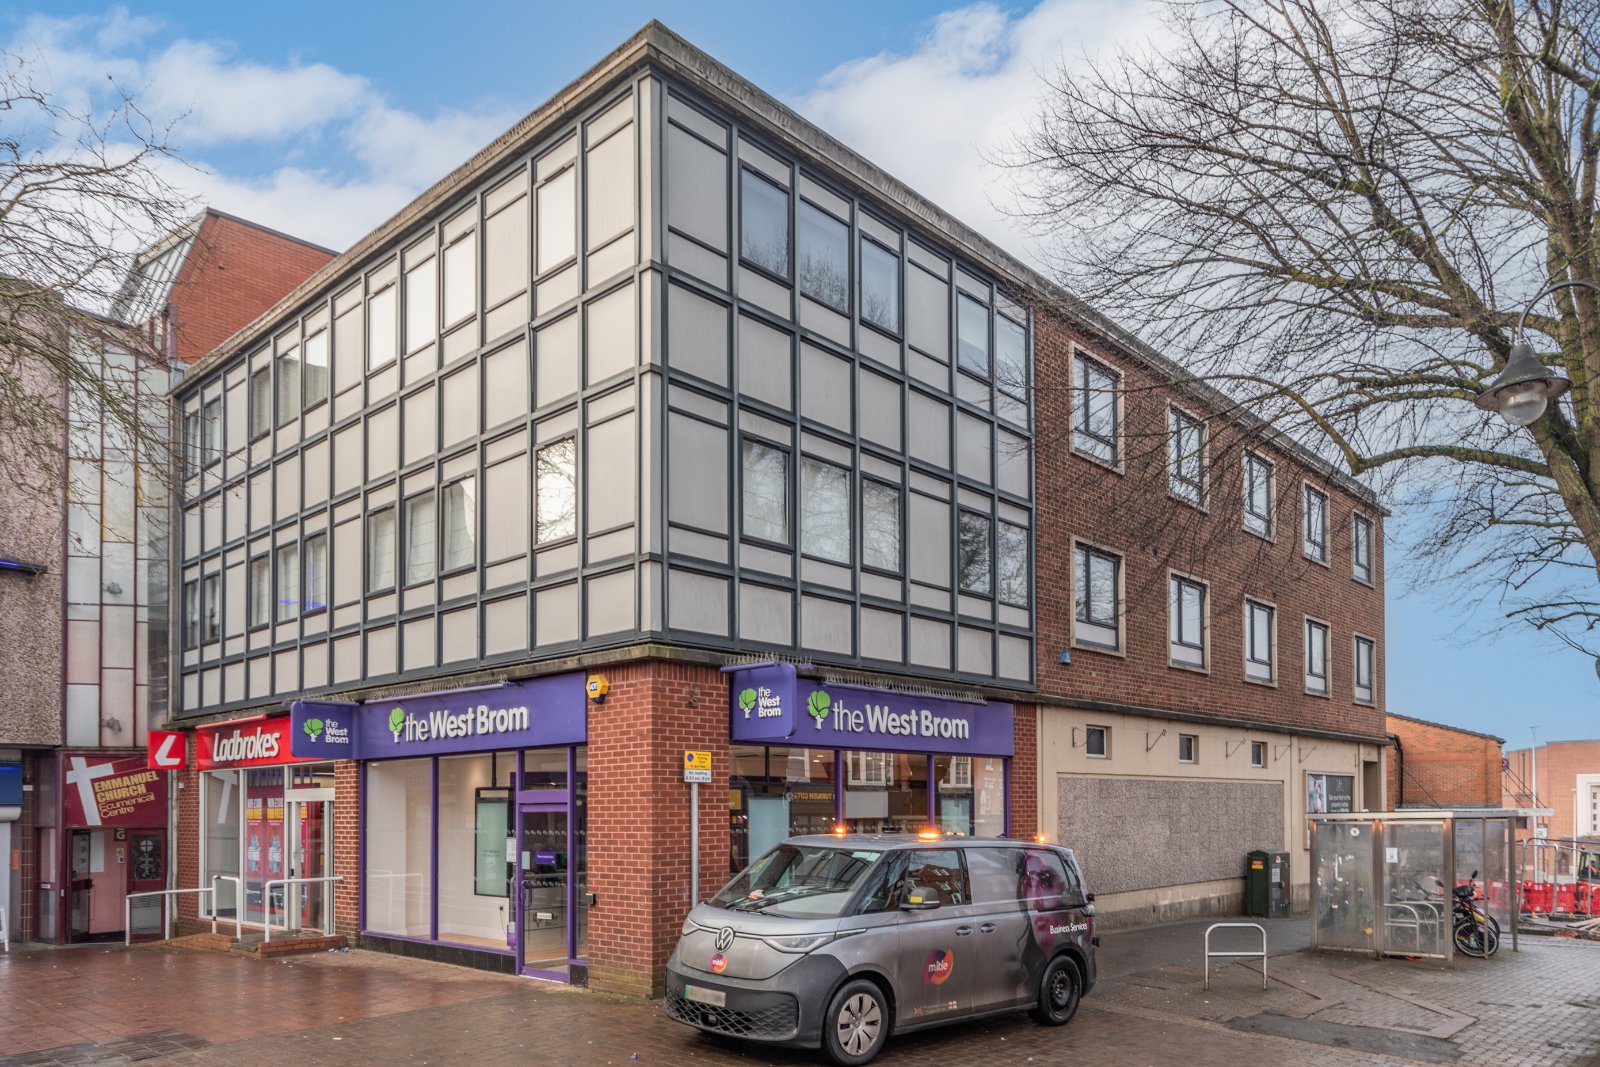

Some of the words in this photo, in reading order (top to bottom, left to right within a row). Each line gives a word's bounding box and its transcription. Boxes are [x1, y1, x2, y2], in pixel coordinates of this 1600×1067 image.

[758, 686, 771, 697] the
[758, 696, 780, 707] West
[758, 707, 781, 718] Brom
[325, 718, 338, 728] the
[404, 712, 428, 742] the
[430, 707, 474, 739] West
[476, 704, 528, 734] Brom
[832, 700, 864, 732] the
[866, 704, 918, 736] West
[920, 710, 969, 739] Brom
[325, 727, 348, 736] West
[212, 726, 280, 762] Ladbrokes
[325, 735, 349, 744] Brom
[94, 770, 159, 792] EMMANUEL
[96, 784, 147, 803] CHURCH
[98, 792, 155, 811] Ecumenical
[101, 806, 134, 818] Centre
[116, 830, 126, 840] G
[1050, 924, 1070, 934] Business
[1070, 922, 1088, 932] Services
